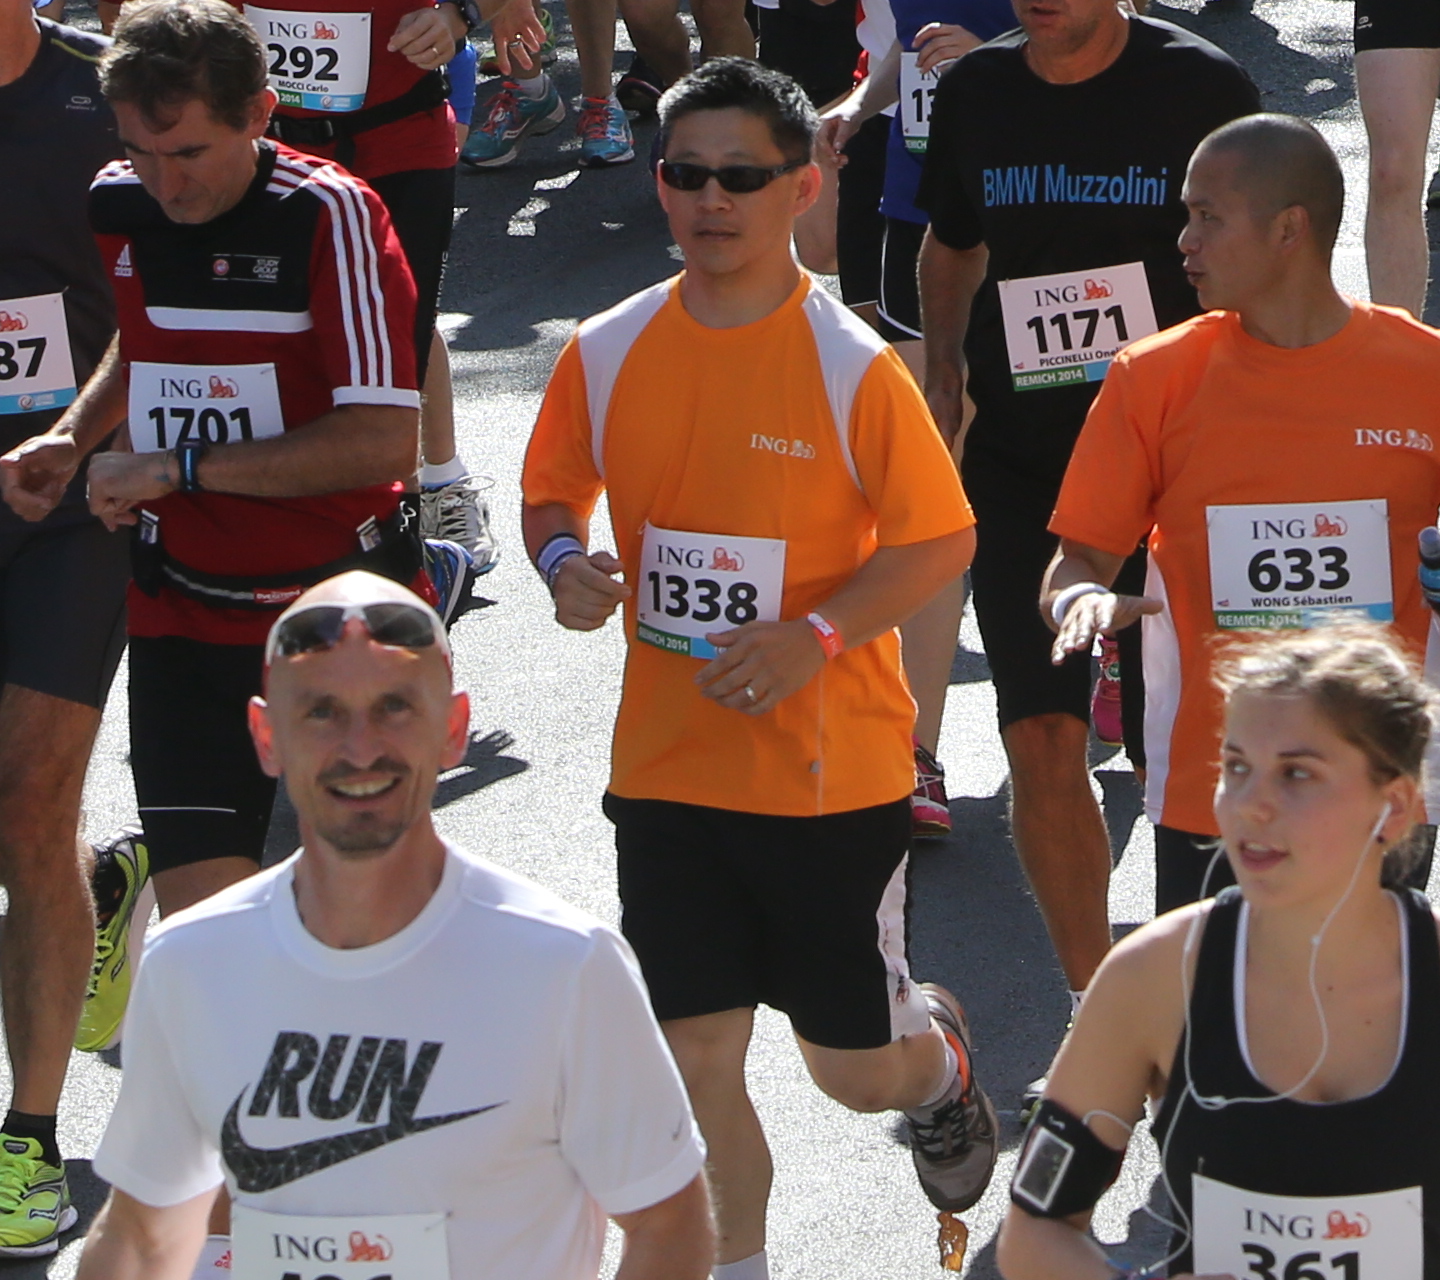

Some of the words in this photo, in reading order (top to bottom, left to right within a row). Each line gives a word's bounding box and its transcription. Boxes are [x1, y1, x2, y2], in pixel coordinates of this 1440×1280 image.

[268, 20, 307, 38] ING
[266, 43, 339, 81] 292
[278, 79, 304, 91] MOCCI
[306, 83, 329, 92] Carlo
[983, 168, 1037, 208] BMW
[1043, 164, 1166, 206] Muzzolini
[1034, 285, 1079, 307] ING
[1026, 305, 1129, 354] 1171
[1039, 350, 1095, 367] PICCINELLI
[160, 377, 203, 399] ING
[1015, 372, 1057, 387] REMICH
[1058, 369, 1083, 383] 2014
[147, 406, 254, 447] 1701
[1355, 428, 1402, 447] ING
[751, 433, 788, 454] ING
[1251, 518, 1306, 541] ING
[657, 544, 704, 570] ING
[1248, 546, 1351, 593] 633
[648, 570, 758, 624] 1338
[1251, 596, 1291, 608] WONG
[1293, 593, 1353, 606] Sébastien
[1218, 613, 1266, 628] REMICH
[1268, 612, 1300, 627] 2014
[666, 636, 689, 653] 2014
[248, 1030, 445, 1124] RUN
[1245, 1208, 1313, 1240] ING
[274, 1232, 338, 1263] ING
